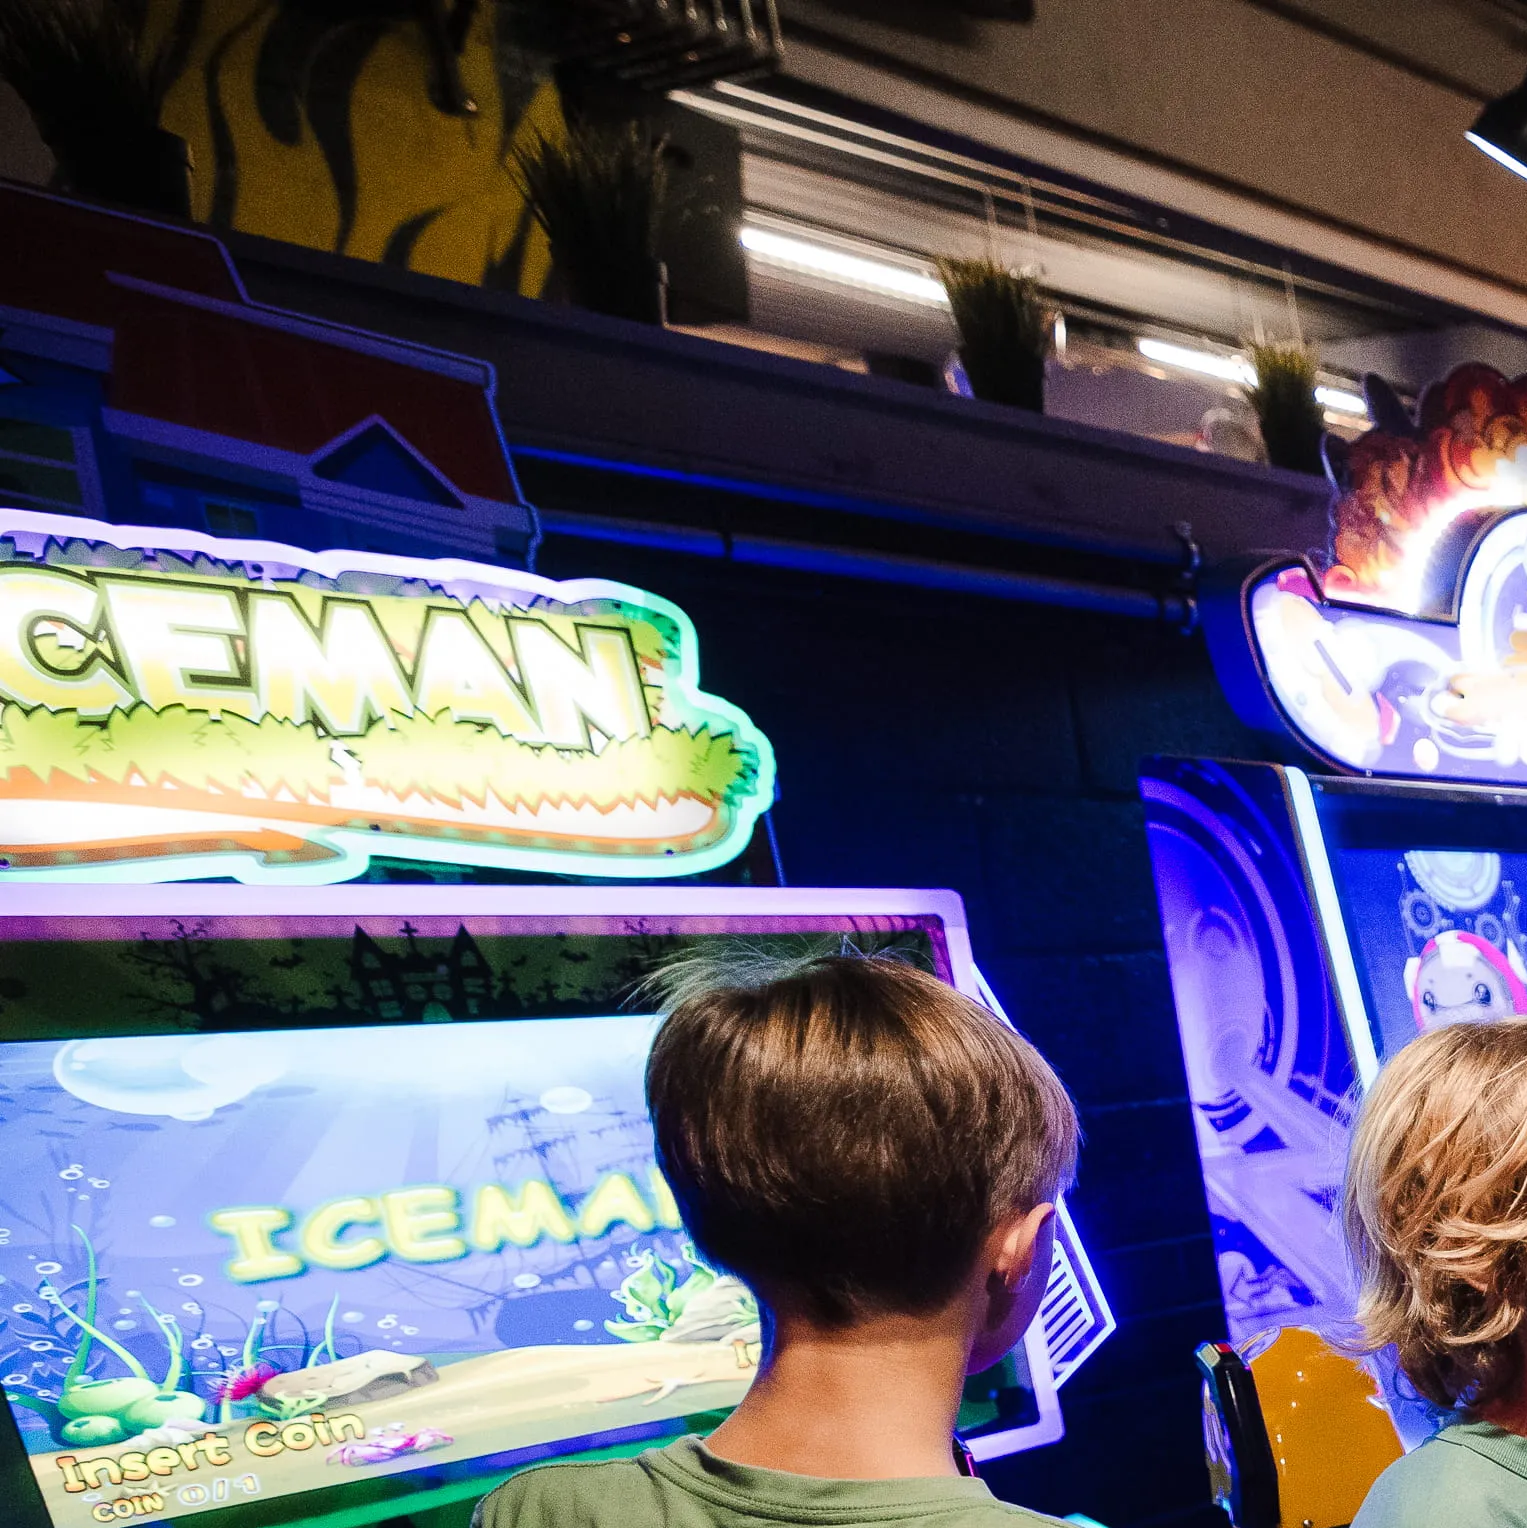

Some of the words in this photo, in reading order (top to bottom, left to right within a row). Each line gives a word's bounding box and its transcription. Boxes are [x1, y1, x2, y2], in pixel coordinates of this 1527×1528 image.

[56, 1432, 232, 1492] Insert
[244, 1413, 365, 1457] Coin
[92, 1492, 164, 1522] COIN
[177, 1474, 260, 1505] 0/1
